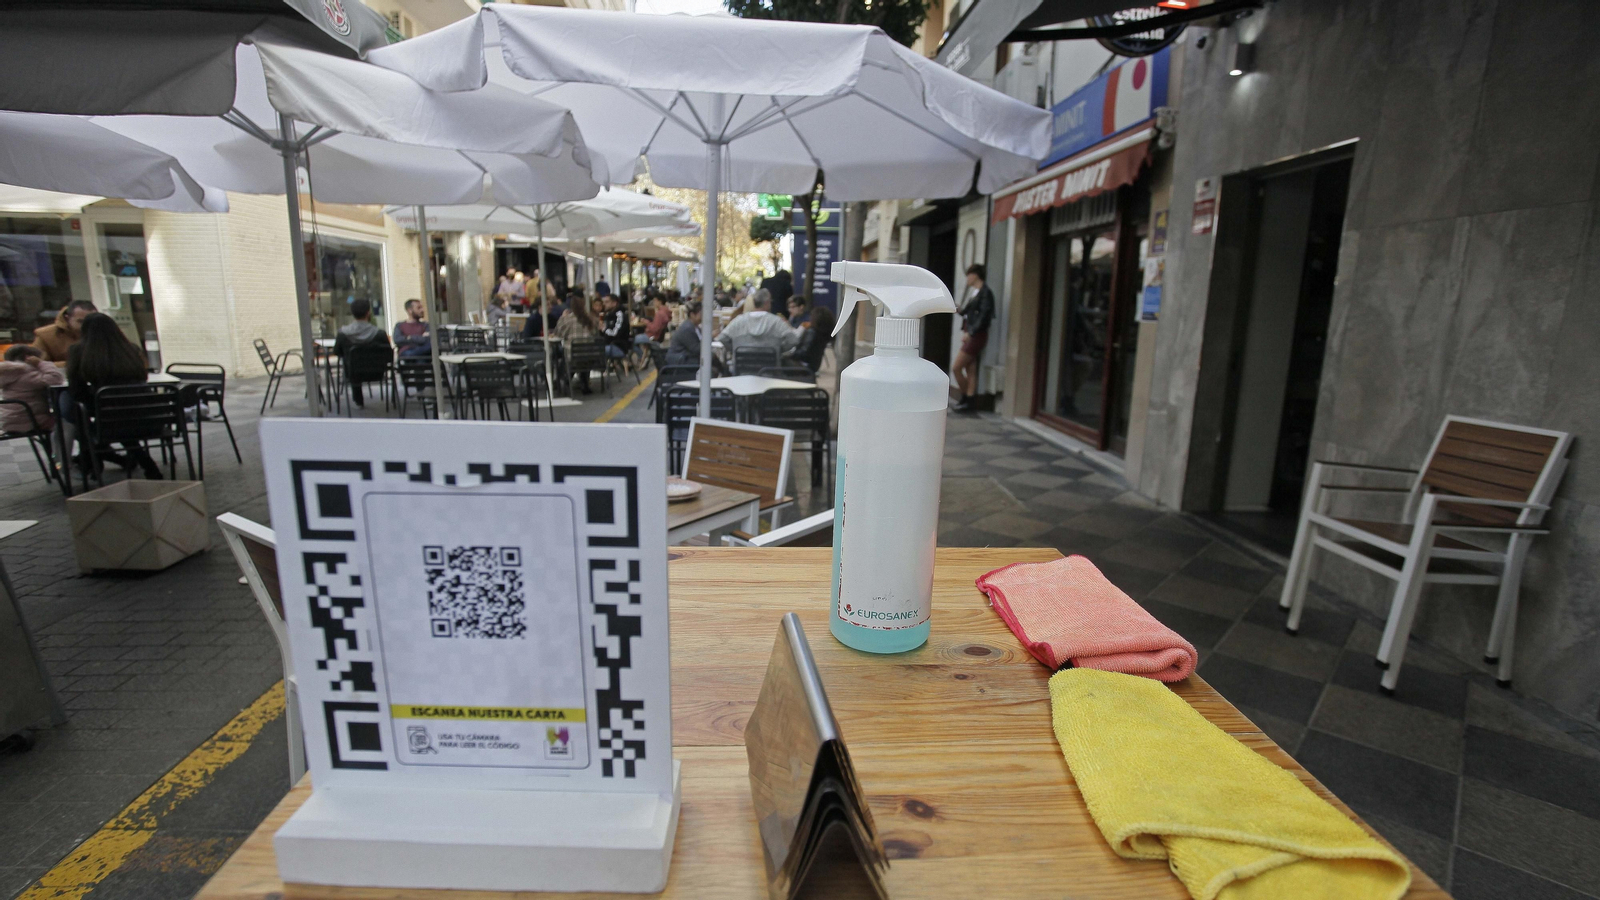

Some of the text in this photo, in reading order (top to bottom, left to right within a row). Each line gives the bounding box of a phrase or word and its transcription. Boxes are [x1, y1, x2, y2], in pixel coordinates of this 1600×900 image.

[1012, 158, 1111, 214] MISTER MINIT
[857, 609, 918, 620] EUROSANEX
[411, 707, 566, 719] ESCANEA NUESTRA CARTA
[487, 741, 519, 749] CÓDIGO
